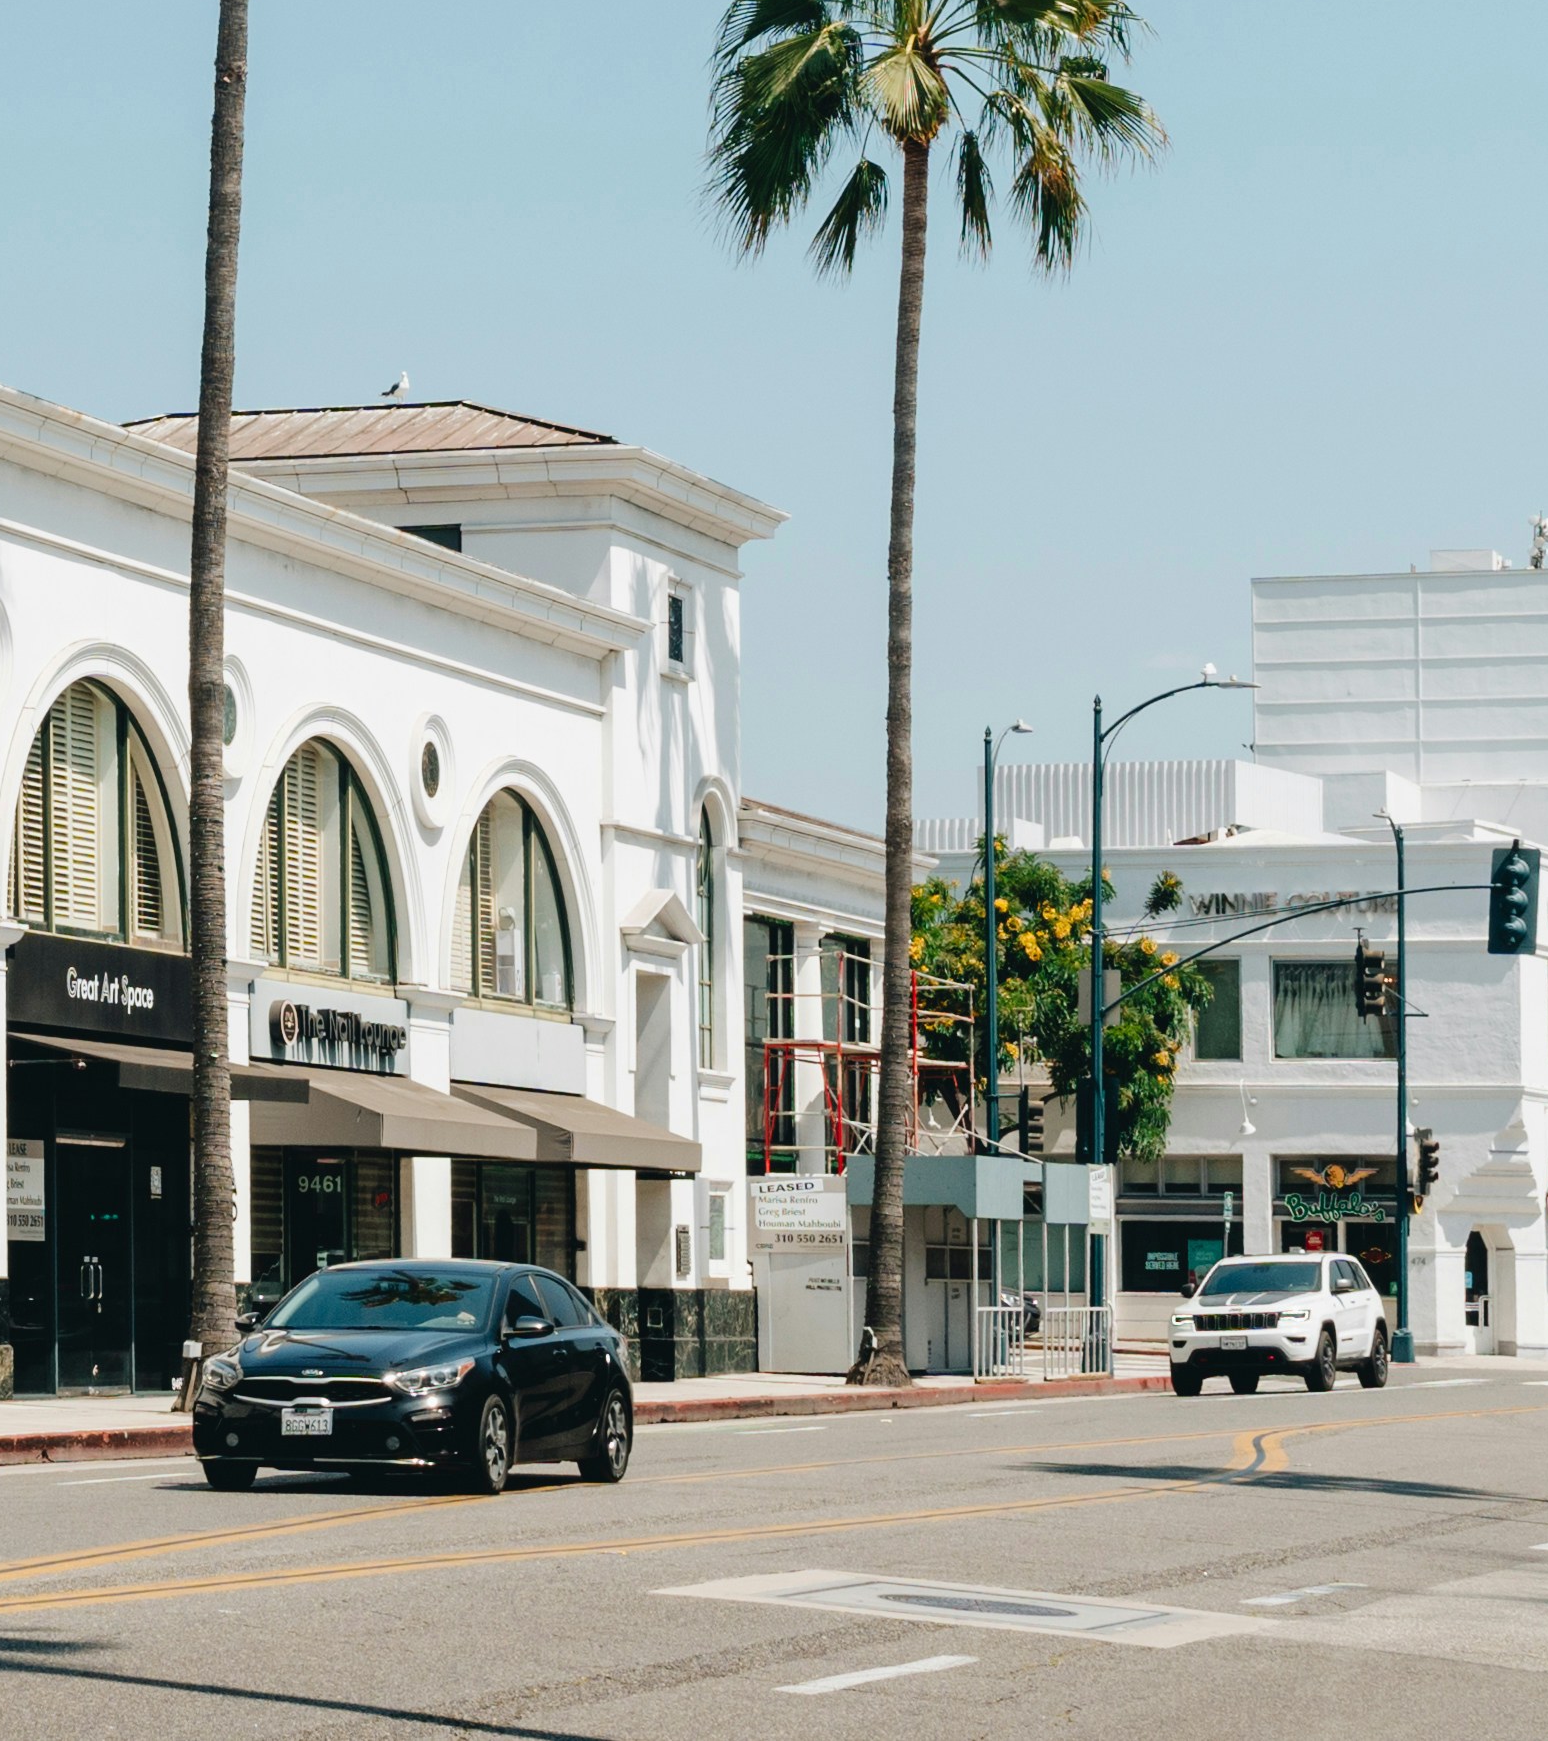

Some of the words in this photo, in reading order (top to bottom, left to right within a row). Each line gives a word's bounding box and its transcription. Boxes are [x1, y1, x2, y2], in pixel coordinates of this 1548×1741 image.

[1188, 892, 1277, 915] WINNIE
[67, 966, 99, 1001] Great
[100, 971, 119, 1004] Art
[121, 974, 154, 1014] Space
[297, 1004, 325, 1039] The
[326, 1009, 356, 1043] Nail
[359, 1013, 407, 1056] Lounge
[9, 1143, 27, 1156] LEASE
[298, 1175, 342, 1193] 9461
[759, 1182, 815, 1194] LEASED
[758, 1195, 787, 1203] Marisa
[790, 1195, 818, 1203] Renfro
[758, 1208, 780, 1217] Greg
[1285, 1192, 1386, 1223] Buffalo's
[18, 1215, 29, 1227] 550
[30, 1215, 43, 1227] 2651
[759, 1220, 795, 1228] Houman
[798, 1219, 841, 1228] Mahboubi
[775, 1234, 793, 1243] 310
[796, 1234, 815, 1243] 550
[818, 1234, 843, 1243] 2651
[1411, 1257, 1426, 1266] 474
[285, 1419, 328, 1432] 8GGW613
